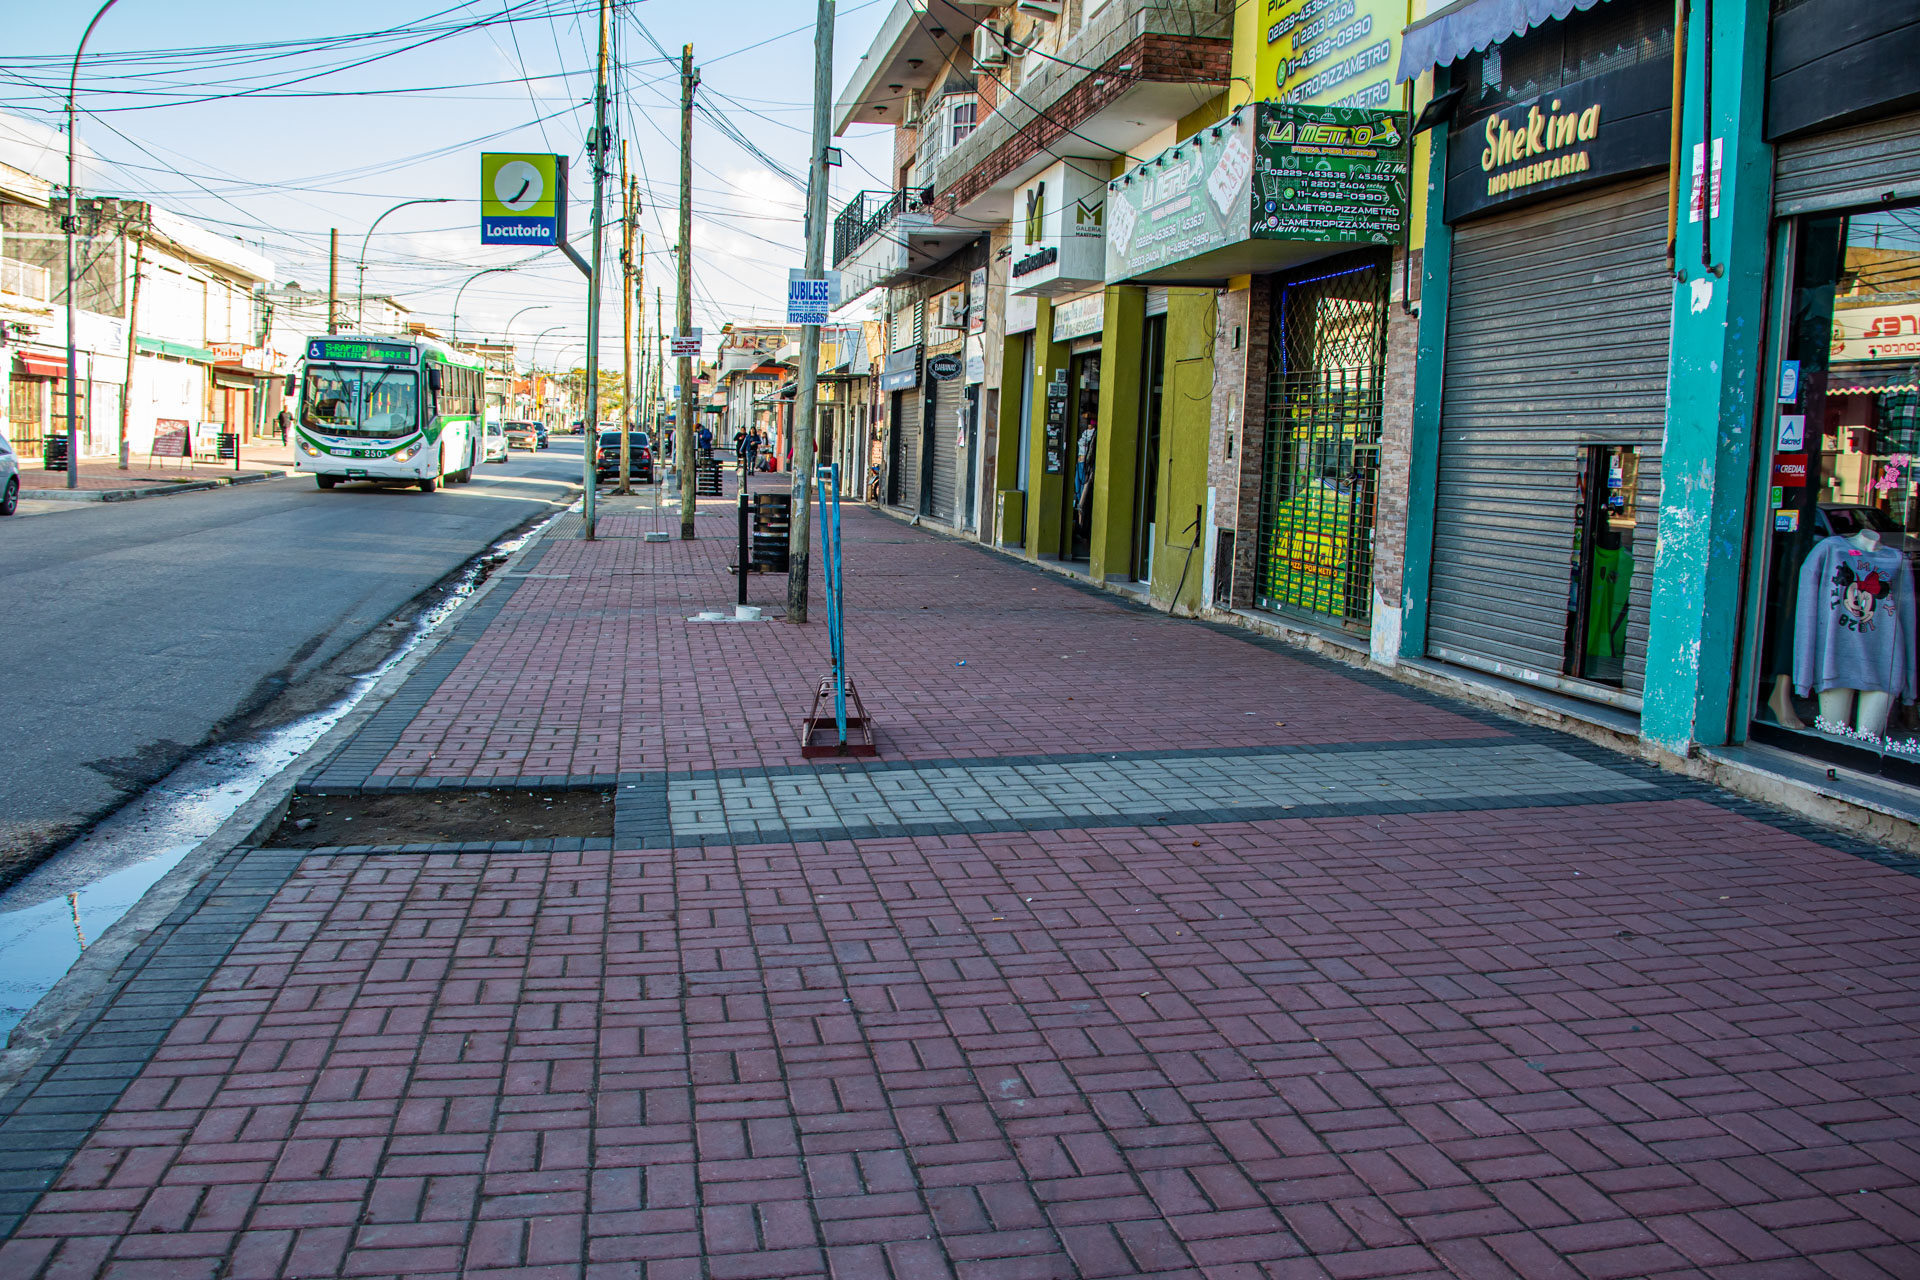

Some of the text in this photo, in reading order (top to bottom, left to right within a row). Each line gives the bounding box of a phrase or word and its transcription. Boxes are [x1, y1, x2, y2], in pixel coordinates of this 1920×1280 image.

[1292, 2, 1354, 50] 11 2203 2404
[1287, 16, 1372, 77] 11-4992-0990
[1268, 120, 1374, 148] LA METRO
[1481, 98, 1601, 172] Shekina
[1269, 169, 1347, 179] 02229-453636
[1358, 173, 1397, 182] 453637
[1487, 150, 1590, 196] INDUMENTARIA
[1301, 180, 1366, 190] 11 2203 2404
[1296, 190, 1382, 202] 11-4992-0990
[1281, 203, 1400, 216] LA.METRO.PIZZAMETRO
[486, 223, 550, 238] Locutorio
[788, 281, 829, 301] JUBILESE
[788, 312, 828, 324] 1125955657
[212, 347, 240, 357] Polo
[364, 450, 383, 458] 250
